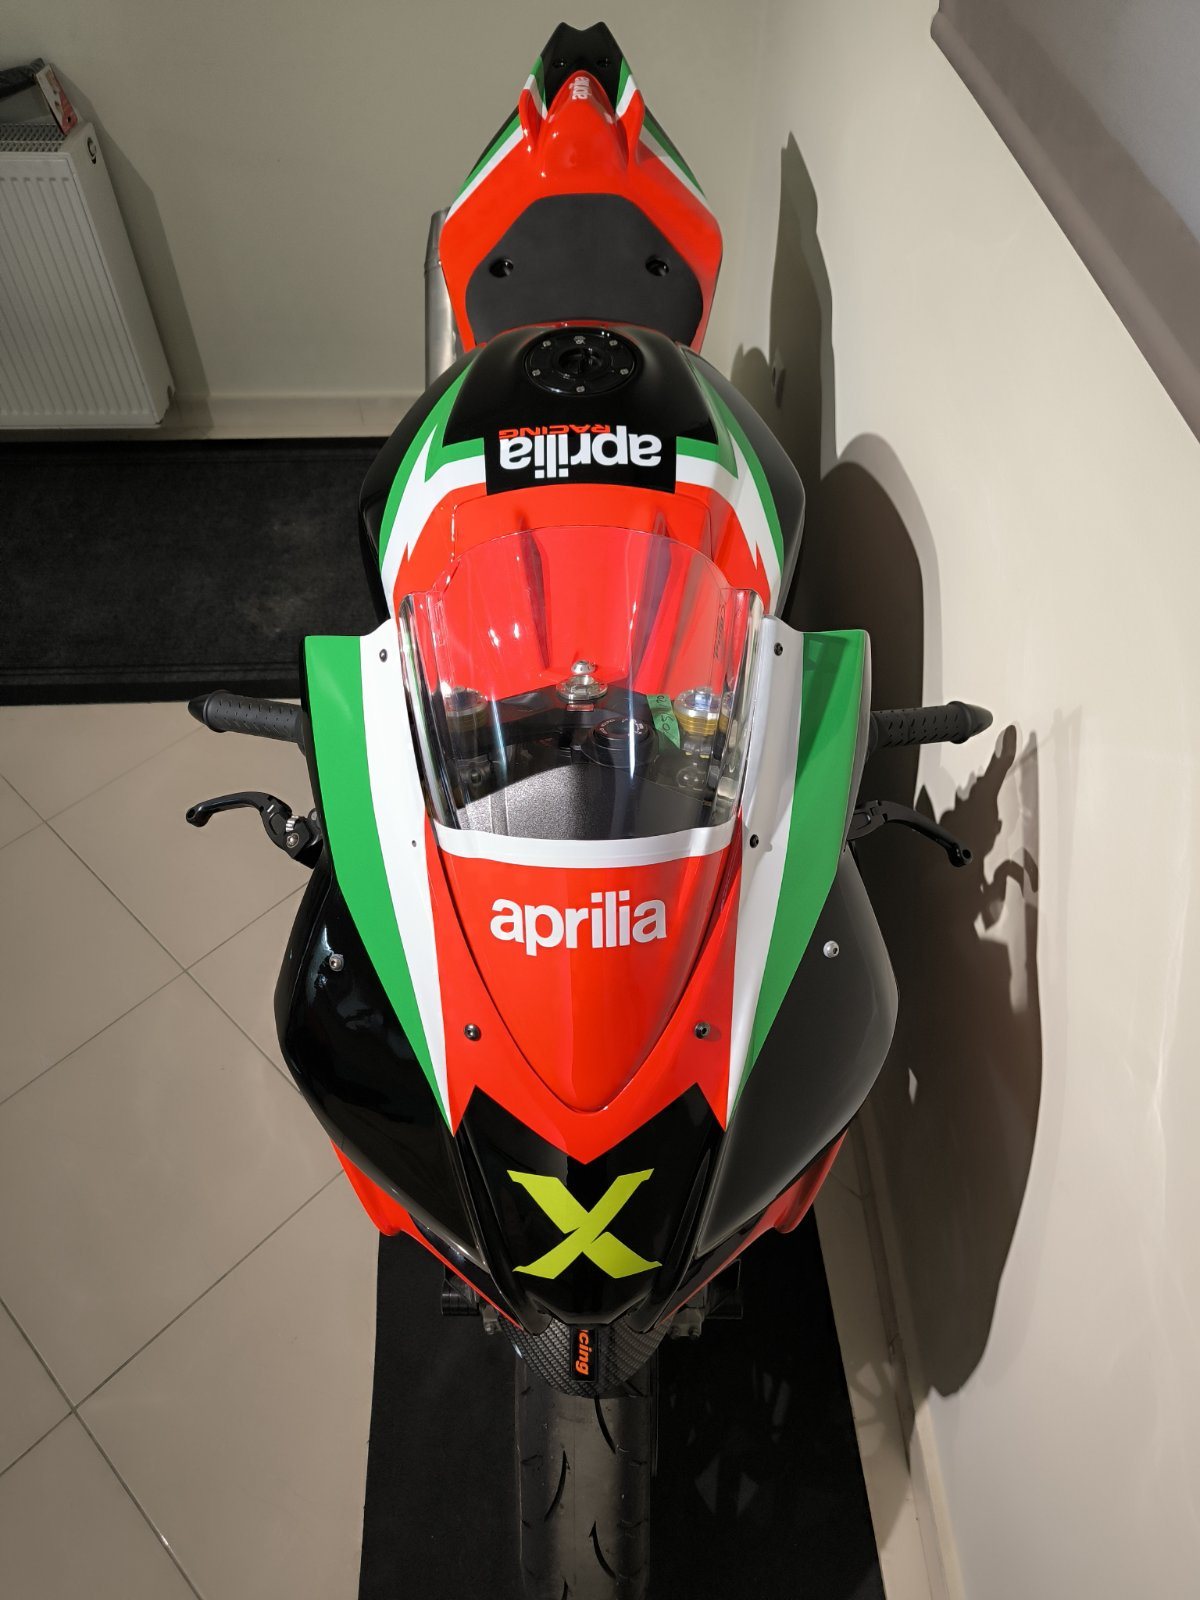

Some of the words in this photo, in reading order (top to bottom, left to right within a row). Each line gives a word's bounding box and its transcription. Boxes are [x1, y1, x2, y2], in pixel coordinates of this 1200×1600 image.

[498, 424, 611, 440] RACING
[499, 425, 663, 479] aprilia
[490, 890, 667, 957] aprilia
[507, 1168, 663, 1280] X
[575, 1329, 592, 1376] cing
